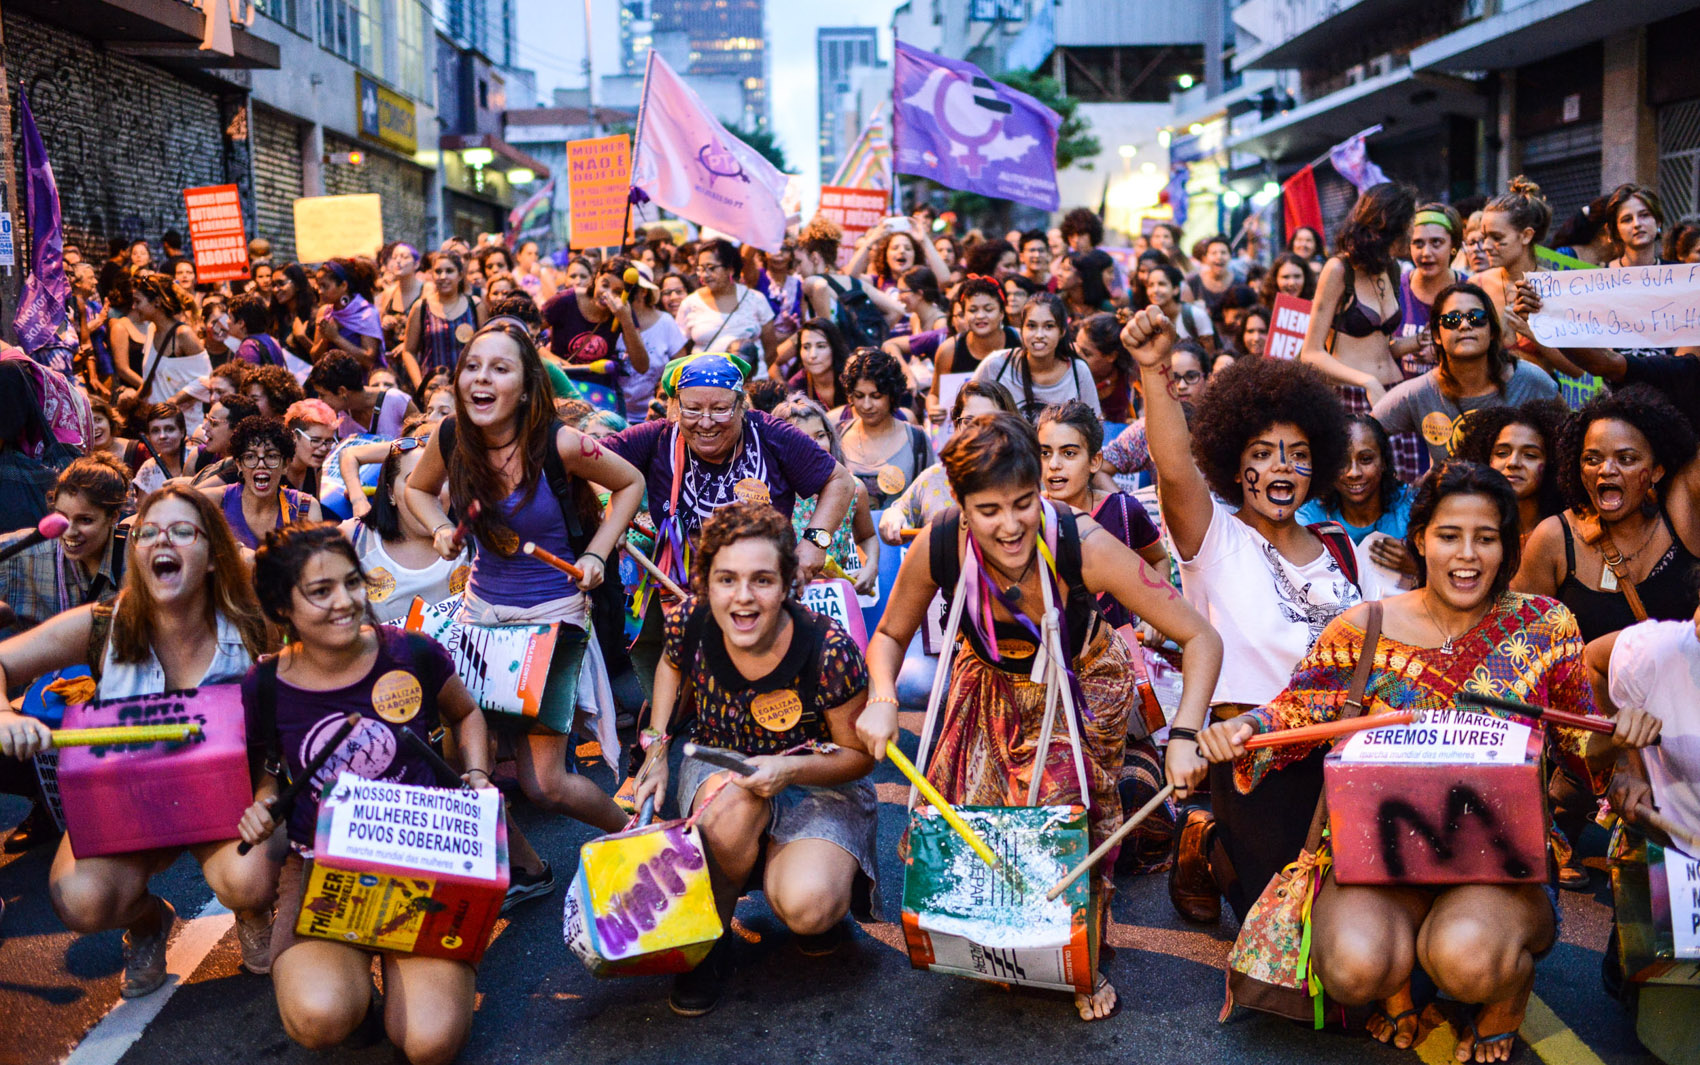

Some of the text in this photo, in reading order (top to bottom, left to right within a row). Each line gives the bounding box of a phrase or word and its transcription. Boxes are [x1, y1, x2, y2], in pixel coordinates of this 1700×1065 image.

[197, 247, 247, 268] ABORTO
[374, 687, 420, 704] LEGALIZAR
[387, 695, 420, 710] ABORTO
[753, 697, 799, 718] LEGALIZAR
[768, 704, 801, 721] ABORTO
[1431, 710, 1451, 725] EM
[1453, 710, 1509, 731] MARCHA
[1364, 729, 1505, 747] SEREMOS LIVRES!
[1389, 750, 1420, 760] mundial
[1438, 750, 1475, 760] mulheres
[353, 785, 401, 804] NOSSOS
[353, 804, 479, 838] MULHERES LIVRES
[348, 822, 483, 858] POVOS SOBERANOS!
